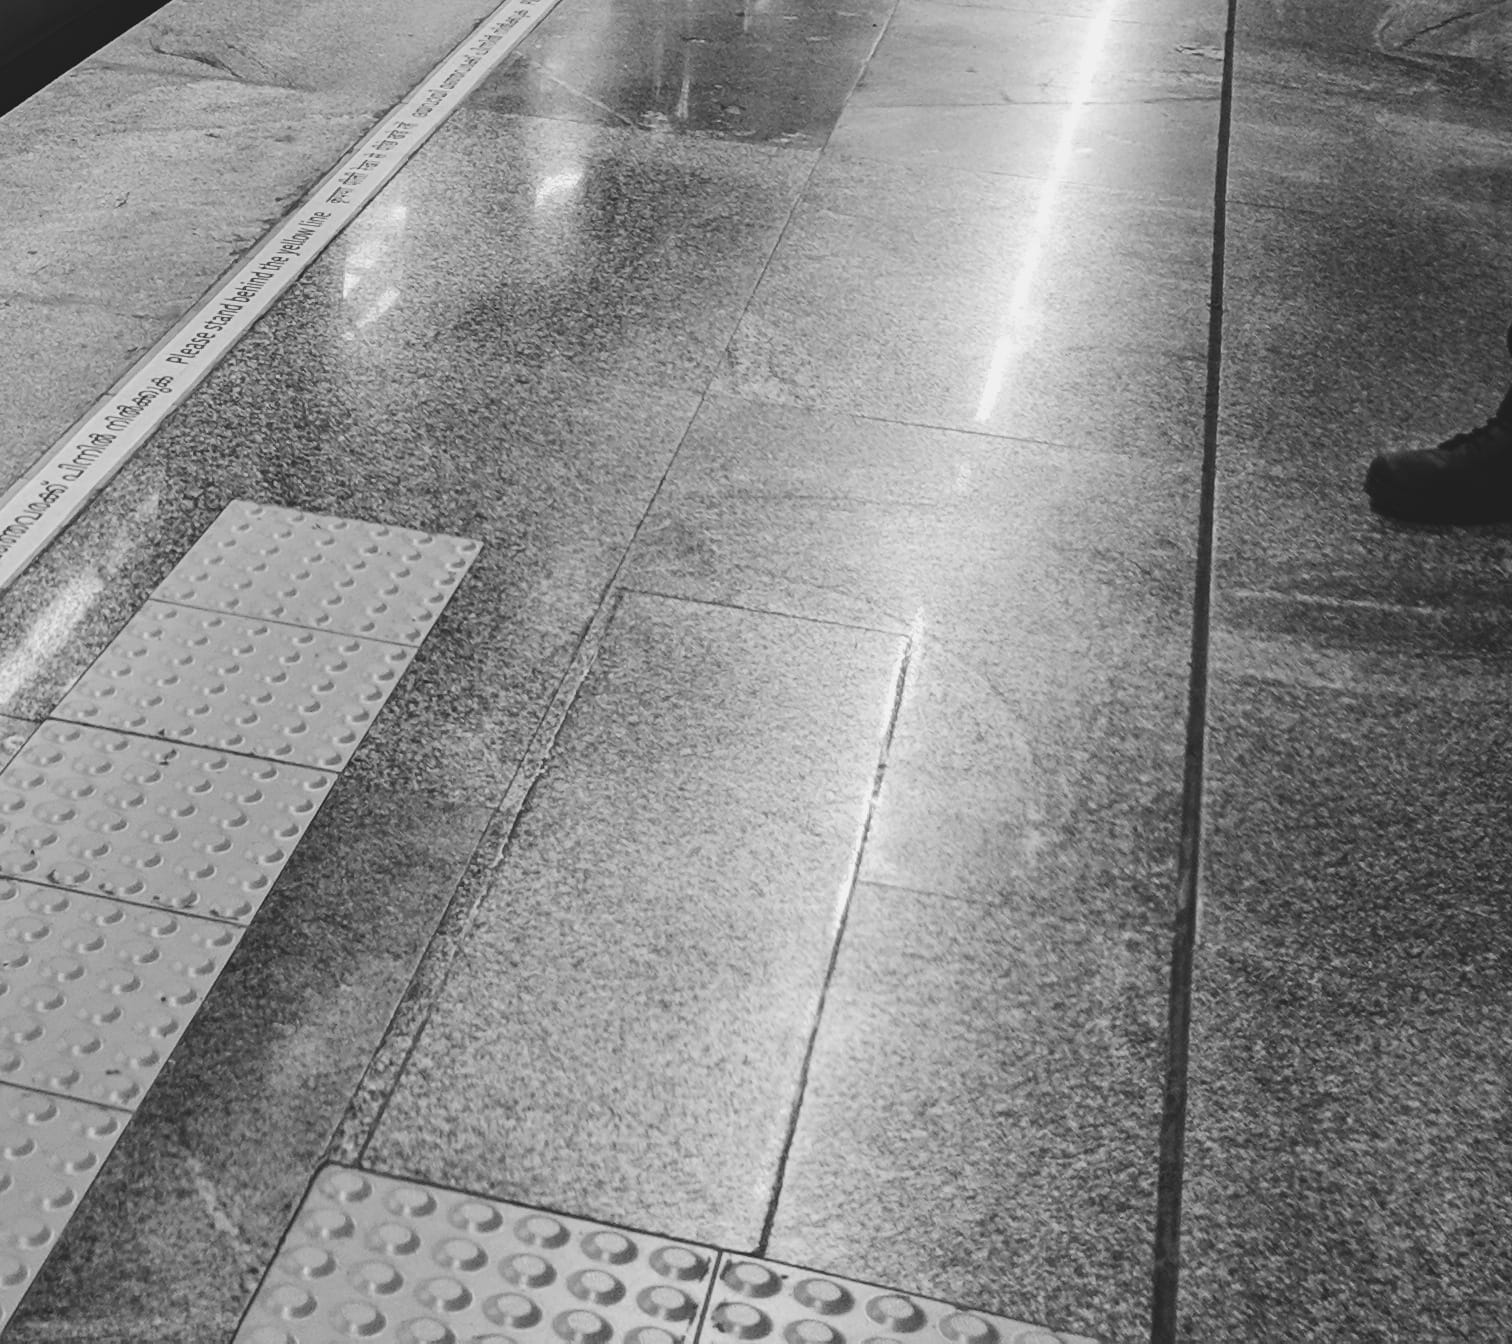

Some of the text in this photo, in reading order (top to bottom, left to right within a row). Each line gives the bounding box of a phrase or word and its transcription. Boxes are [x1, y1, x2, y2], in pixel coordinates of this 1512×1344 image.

[166, 211, 331, 365] Please stand behind the yellow line
